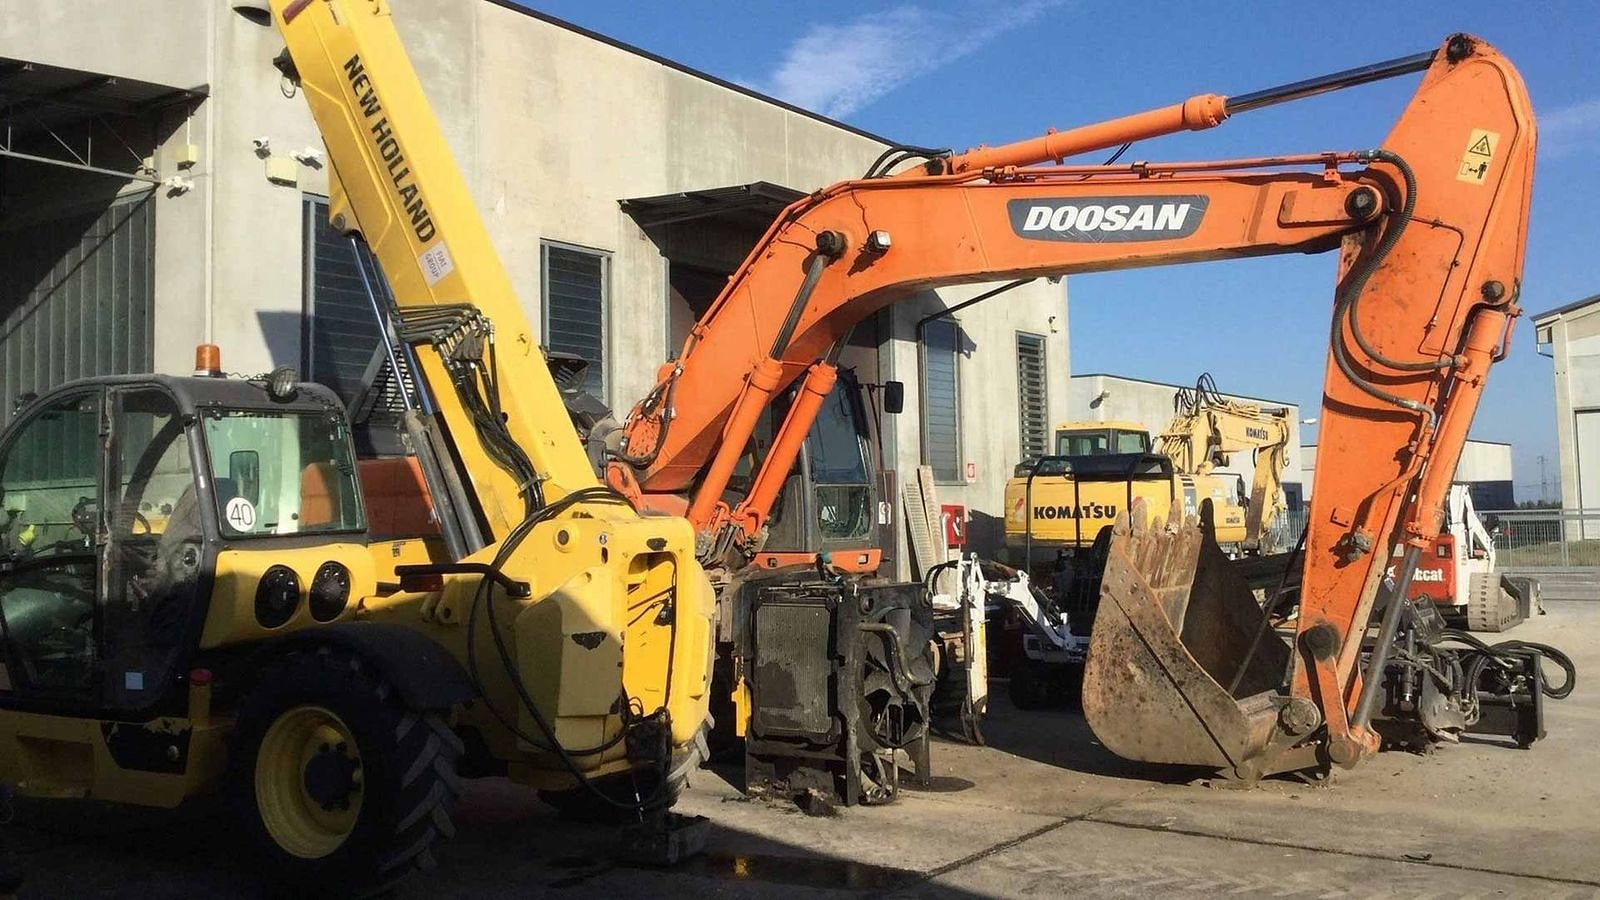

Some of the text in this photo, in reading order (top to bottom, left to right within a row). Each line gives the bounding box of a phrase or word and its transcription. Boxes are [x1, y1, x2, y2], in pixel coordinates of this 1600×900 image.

[343, 53, 436, 243] NEW HOLLAND
[1022, 203, 1191, 232] DOOSAN
[230, 503, 254, 526] 40
[1033, 502, 1116, 520] KOMATSU
[1411, 567, 1444, 582] bcat
